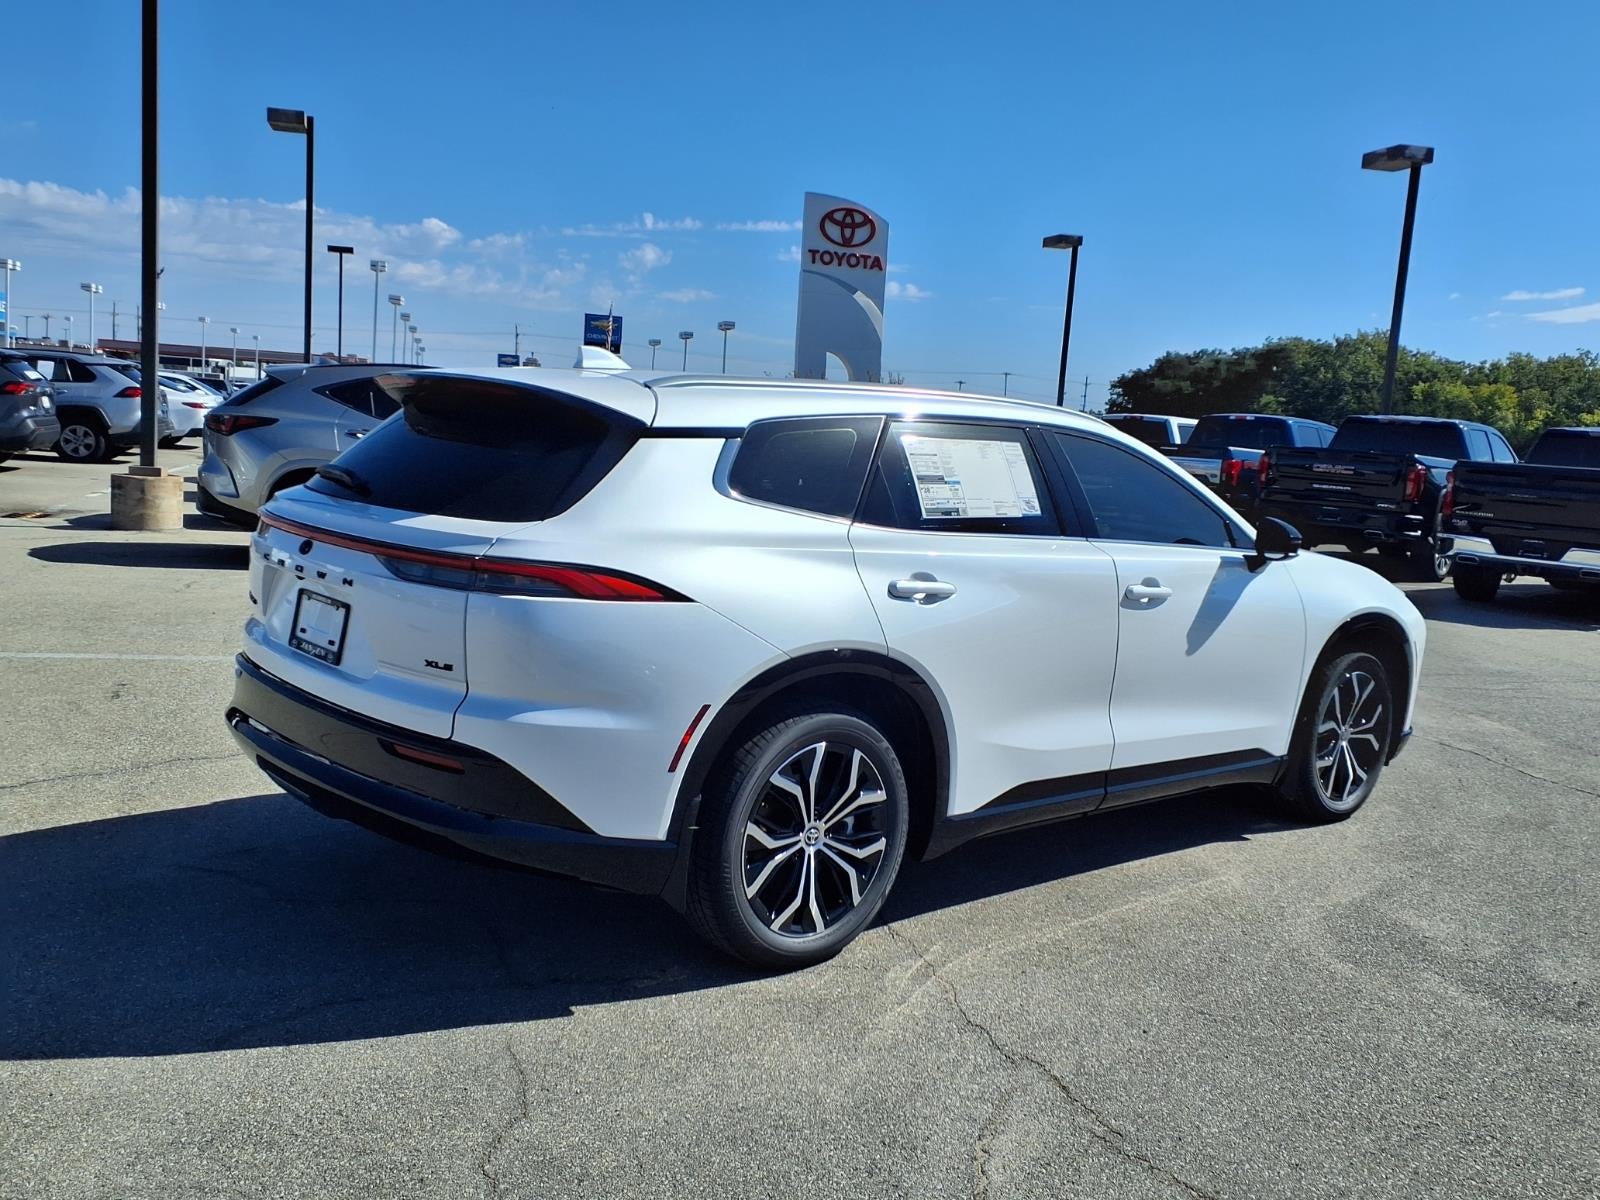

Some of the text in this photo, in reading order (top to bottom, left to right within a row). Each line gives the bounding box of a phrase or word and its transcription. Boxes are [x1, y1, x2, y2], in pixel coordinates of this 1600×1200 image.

[808, 249, 883, 271] TOYOTA
[264, 553, 353, 587] CROWN
[424, 659, 454, 672] XLE
